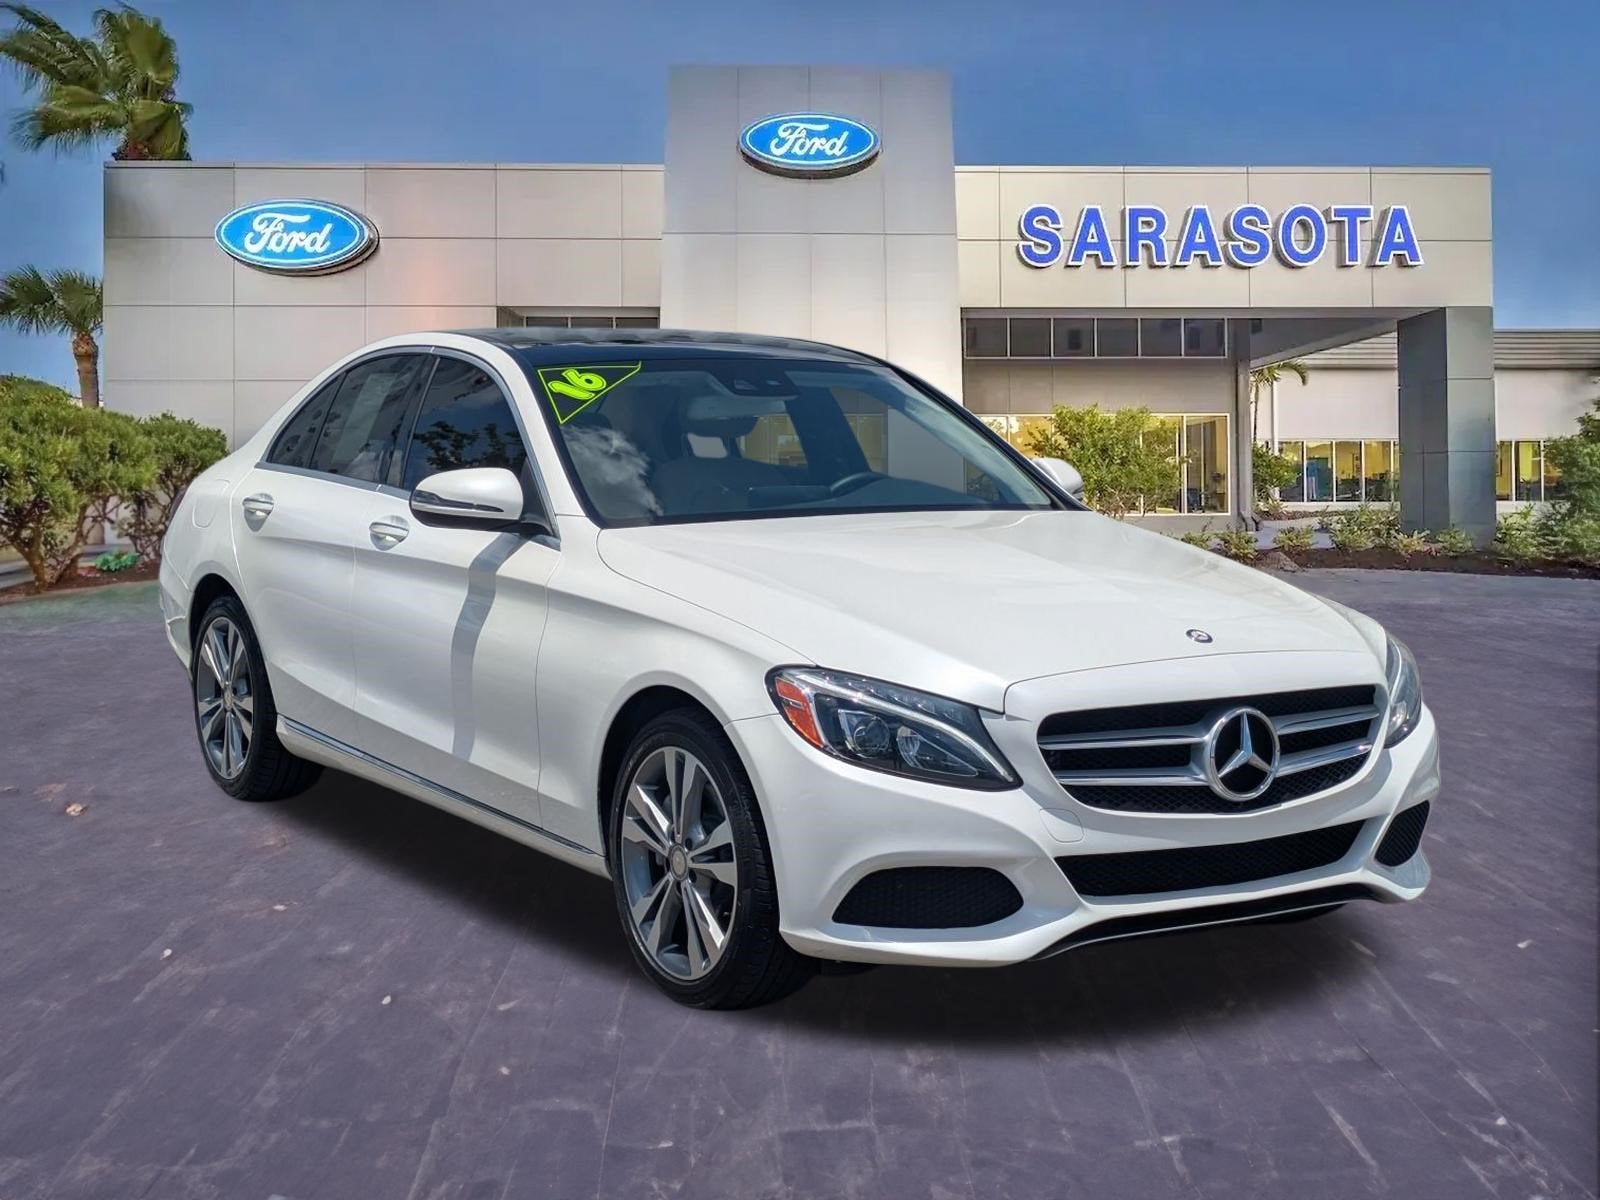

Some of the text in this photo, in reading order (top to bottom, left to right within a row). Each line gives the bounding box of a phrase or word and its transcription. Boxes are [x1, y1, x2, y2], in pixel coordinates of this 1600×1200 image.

[770, 122, 849, 157] Ford
[244, 212, 333, 254] Ford
[1018, 204, 1424, 268] SARASOTA
[547, 368, 607, 400] 16
